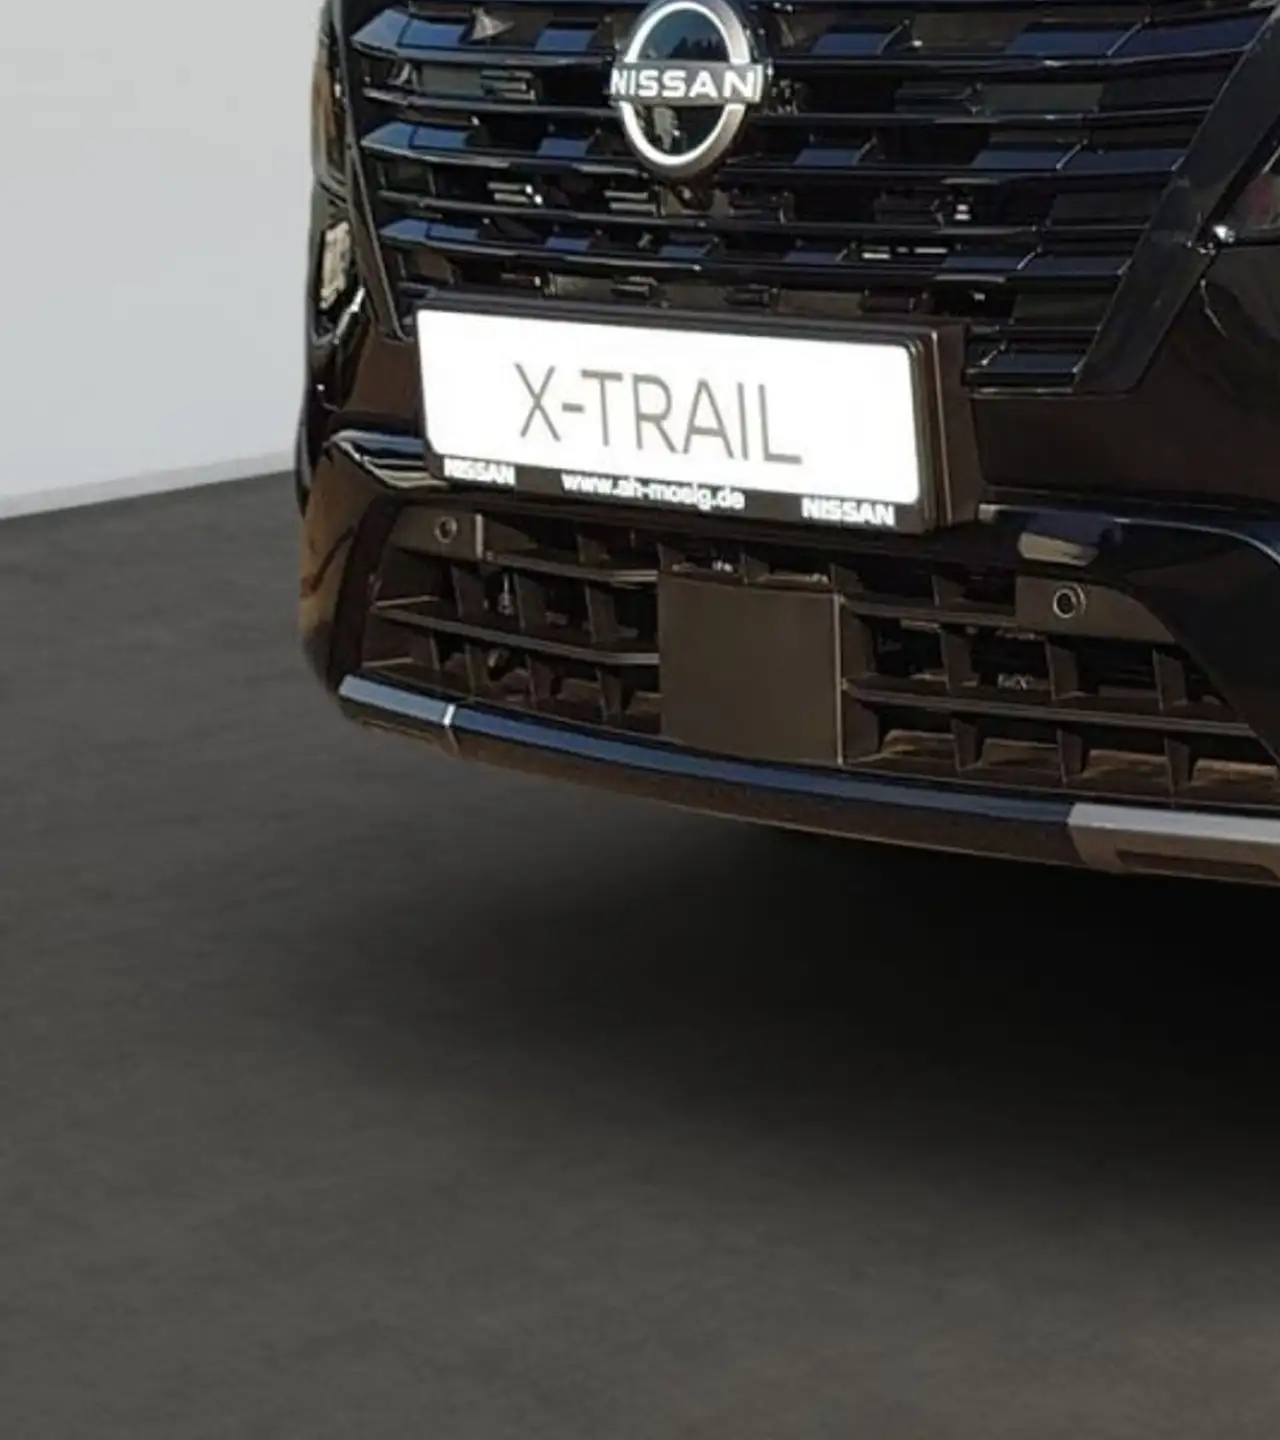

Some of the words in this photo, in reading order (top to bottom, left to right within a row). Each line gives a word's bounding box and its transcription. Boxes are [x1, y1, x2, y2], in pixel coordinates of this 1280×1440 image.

[610, 69, 755, 98] NISSAN
[513, 362, 803, 465] X-TRAIL
[444, 458, 515, 485] NISSAN
[801, 497, 895, 527] NISSAN
